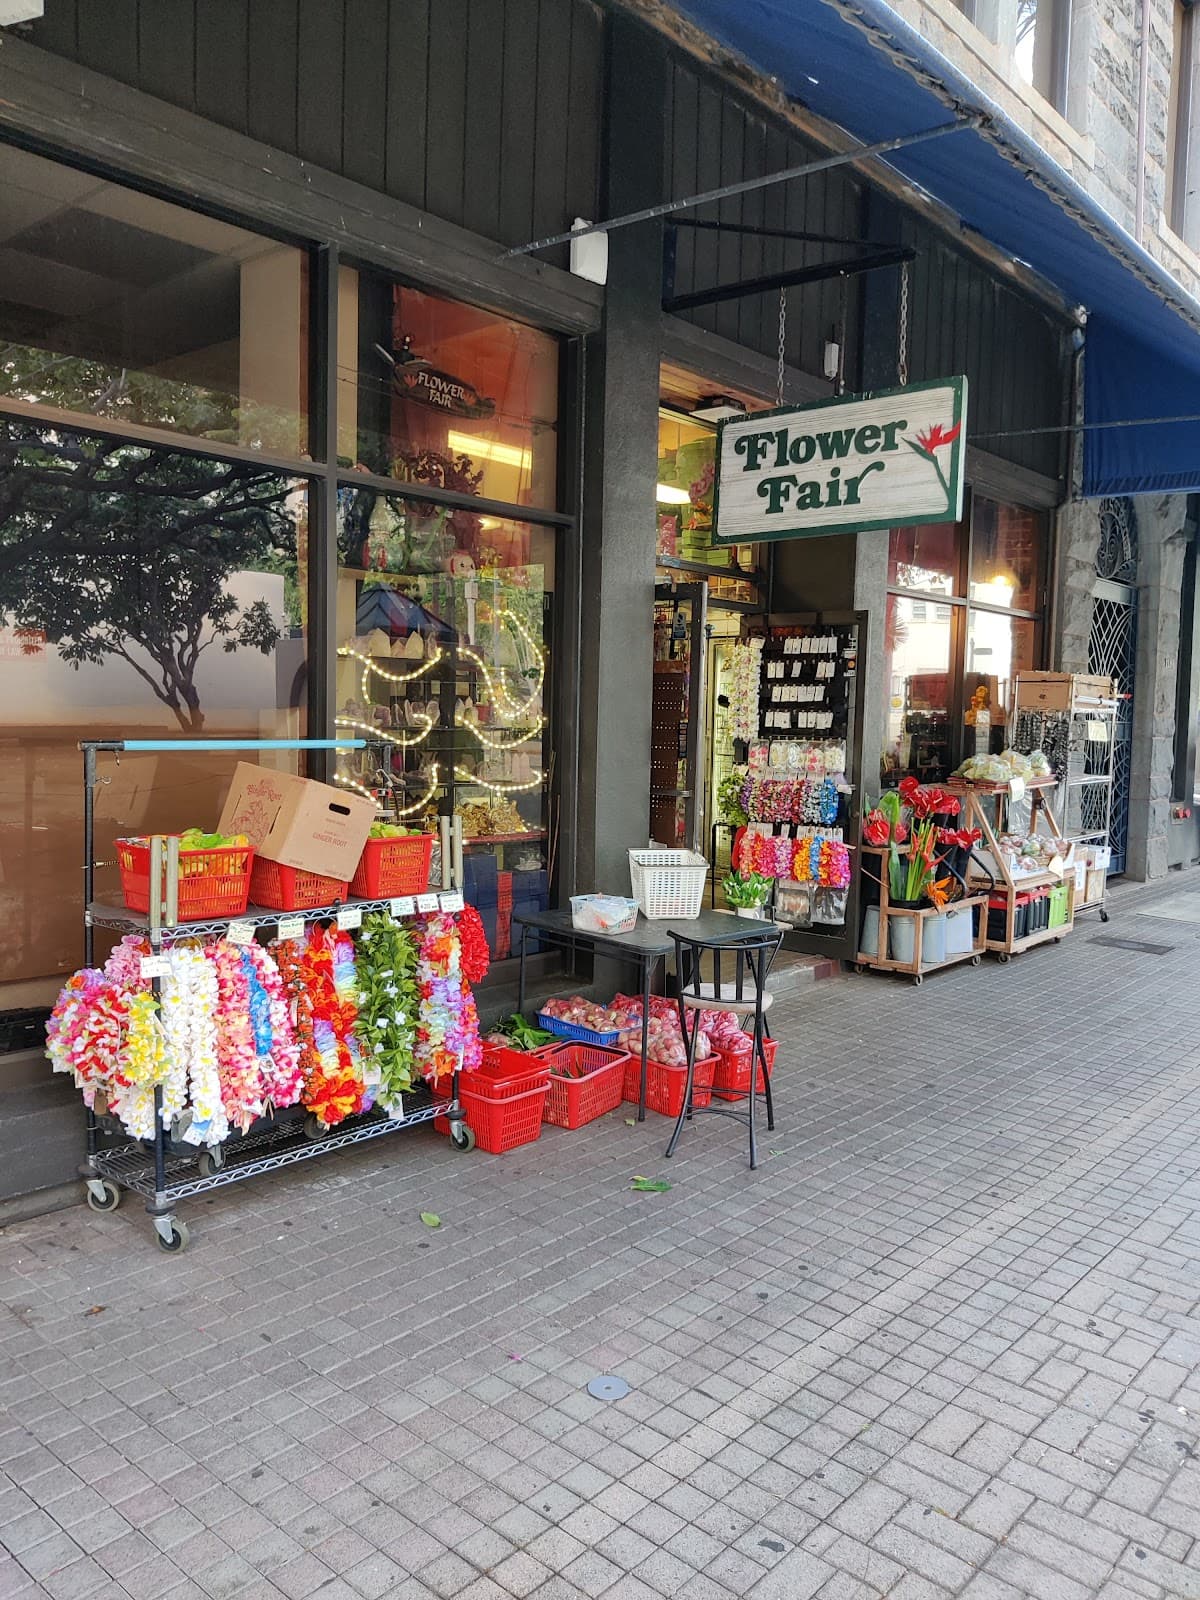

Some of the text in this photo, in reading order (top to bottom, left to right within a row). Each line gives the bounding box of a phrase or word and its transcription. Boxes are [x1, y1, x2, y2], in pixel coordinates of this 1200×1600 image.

[418, 372, 465, 399] FLOWER
[429, 389, 453, 408] FAIR
[734, 419, 908, 472] Flower
[756, 460, 886, 514] Fair
